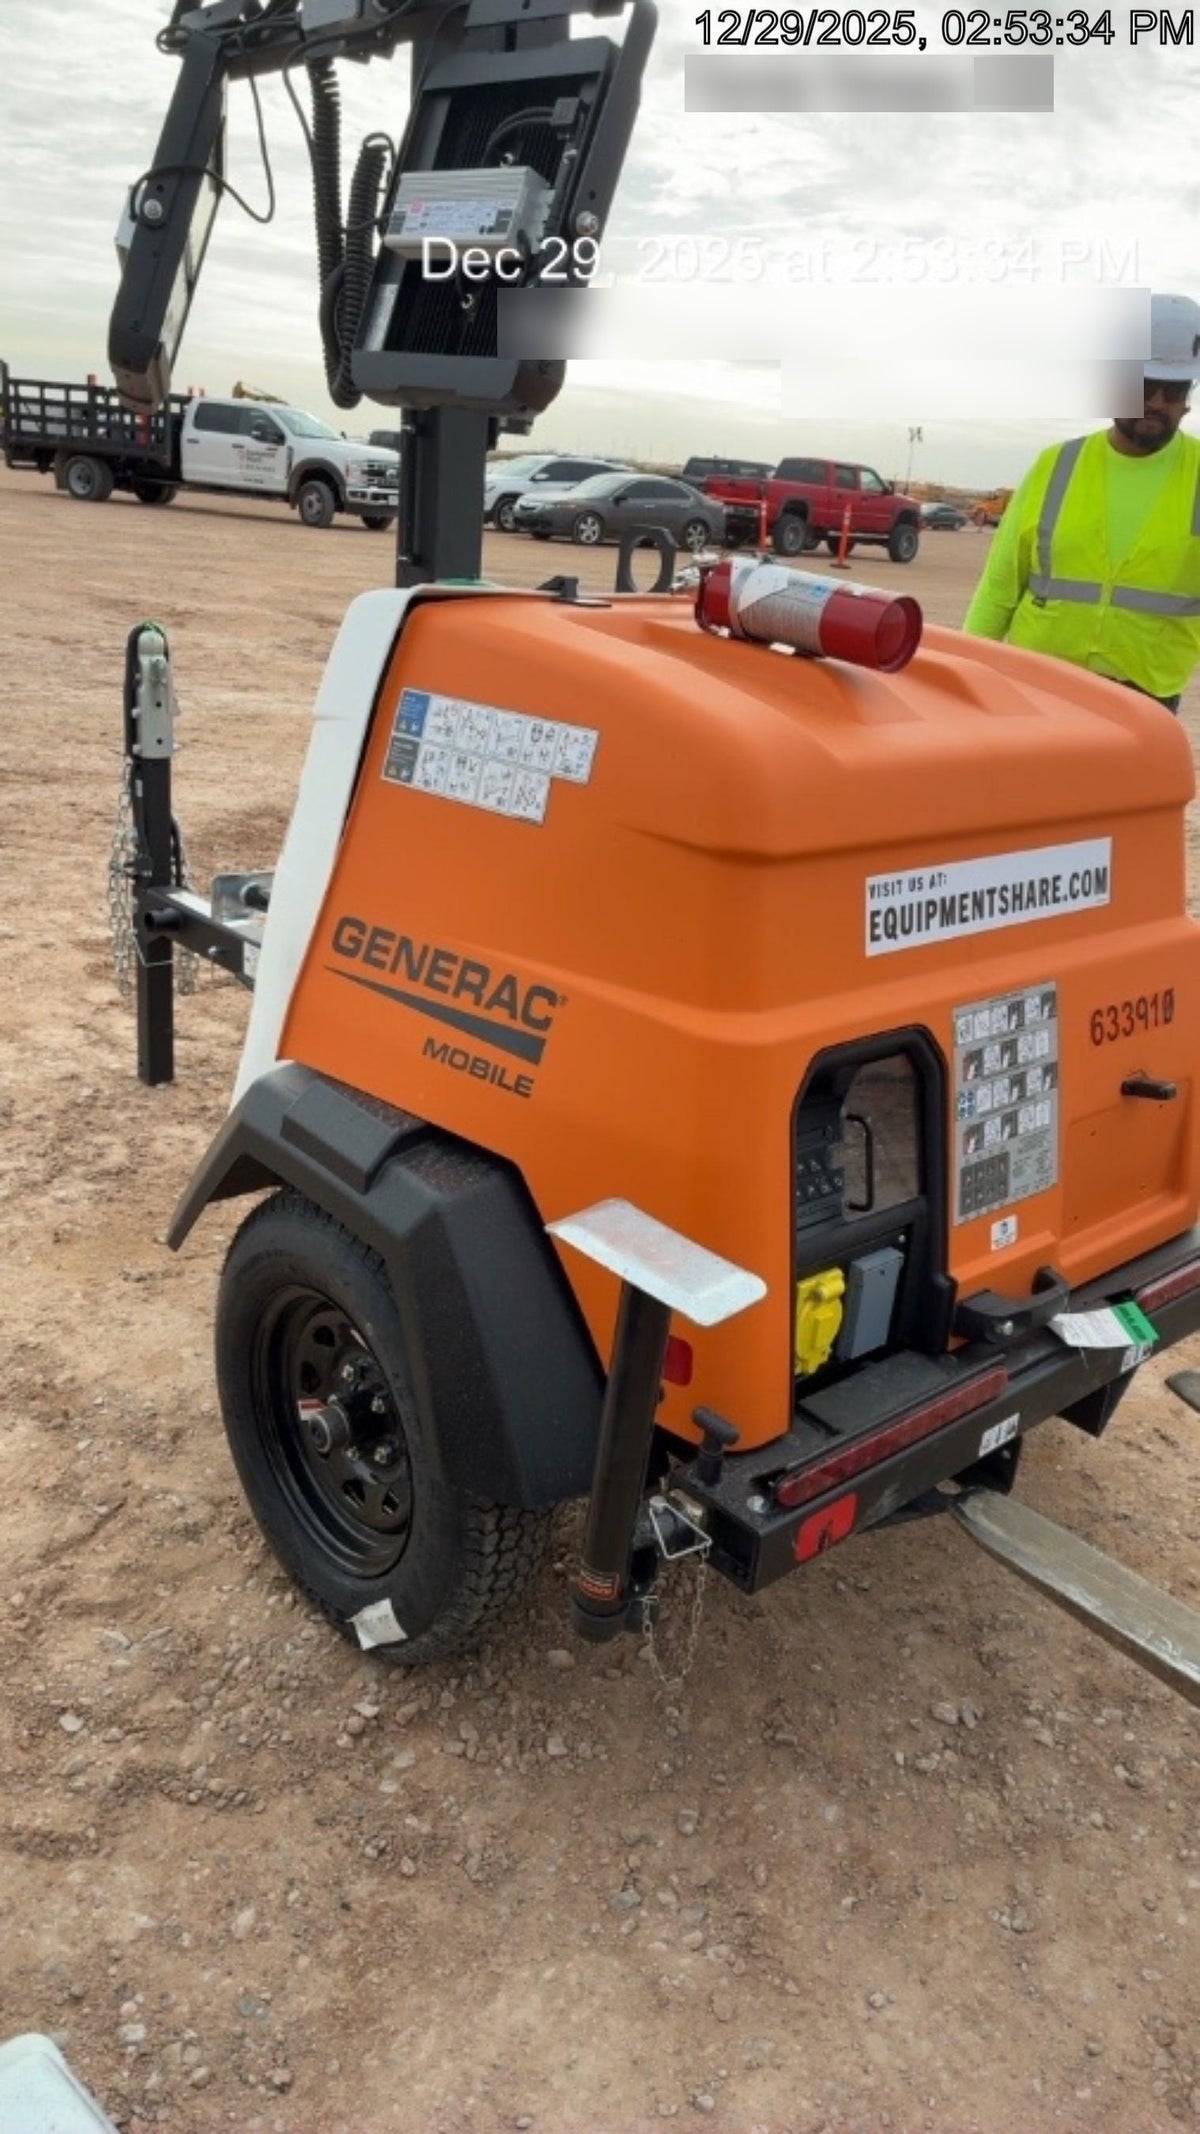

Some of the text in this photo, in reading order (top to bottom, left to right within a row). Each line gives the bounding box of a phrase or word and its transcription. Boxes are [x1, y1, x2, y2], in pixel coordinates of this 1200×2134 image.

[869, 872, 947, 900] VISIT US AT:
[869, 866, 1107, 943] EQUIPMENTSHARE.COM
[331, 916, 558, 1032] GENERAC
[1090, 987, 1175, 1047] 633910
[422, 1037, 535, 1099] MOBILE
